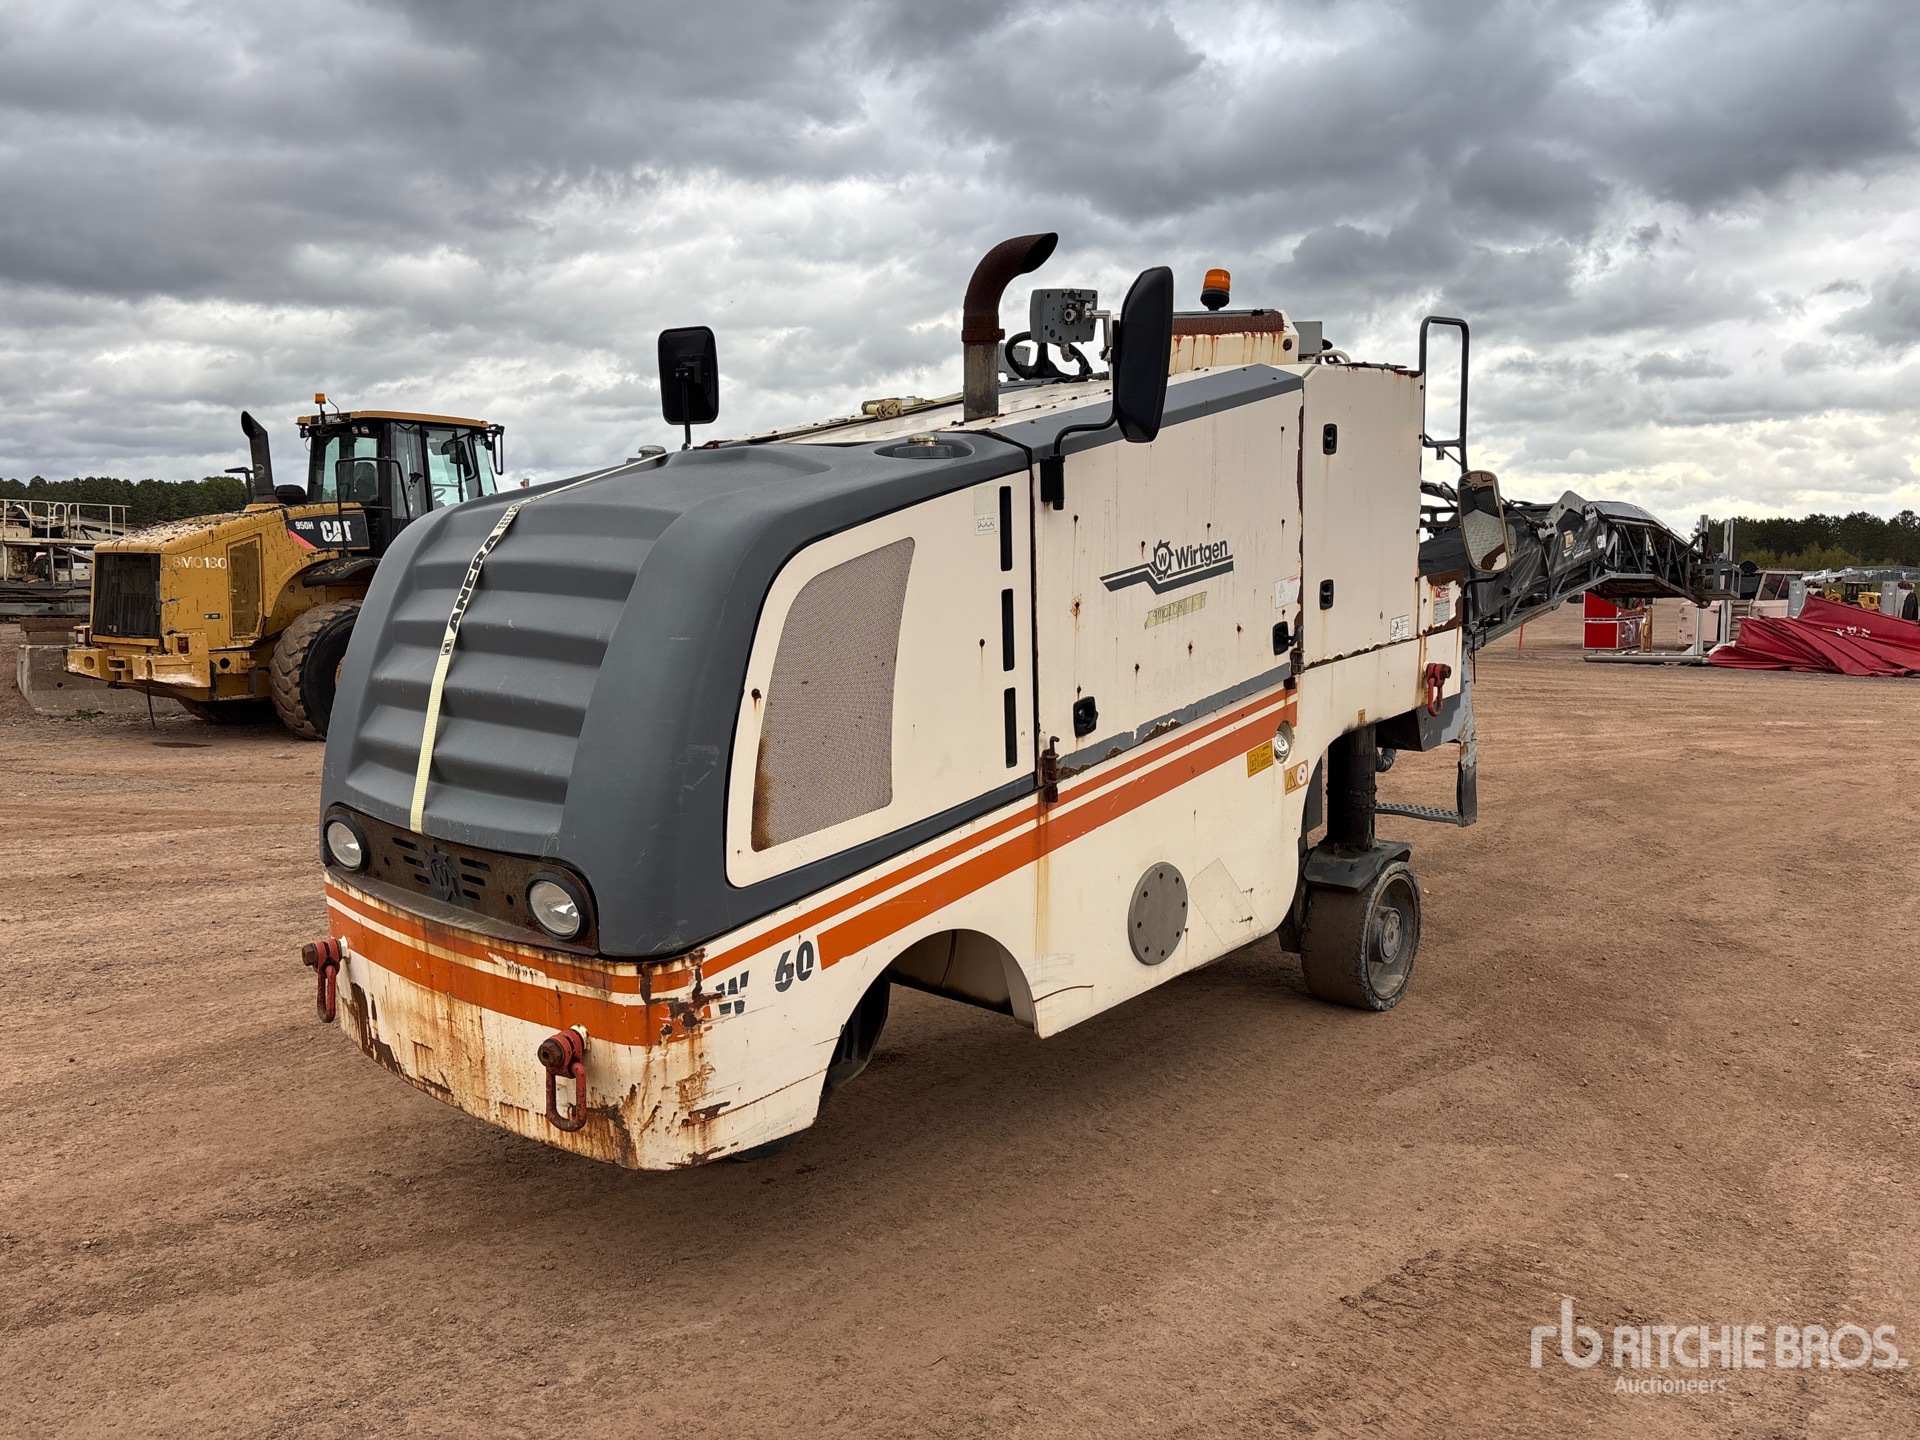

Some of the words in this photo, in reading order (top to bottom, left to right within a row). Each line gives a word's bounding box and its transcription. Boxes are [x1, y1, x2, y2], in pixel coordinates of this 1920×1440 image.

[294, 520, 315, 531] 950H
[319, 520, 353, 542] CAT
[1174, 540, 1228, 570] Wirtgen
[449, 533, 501, 634] ANCRA
[774, 940, 815, 993] 60
